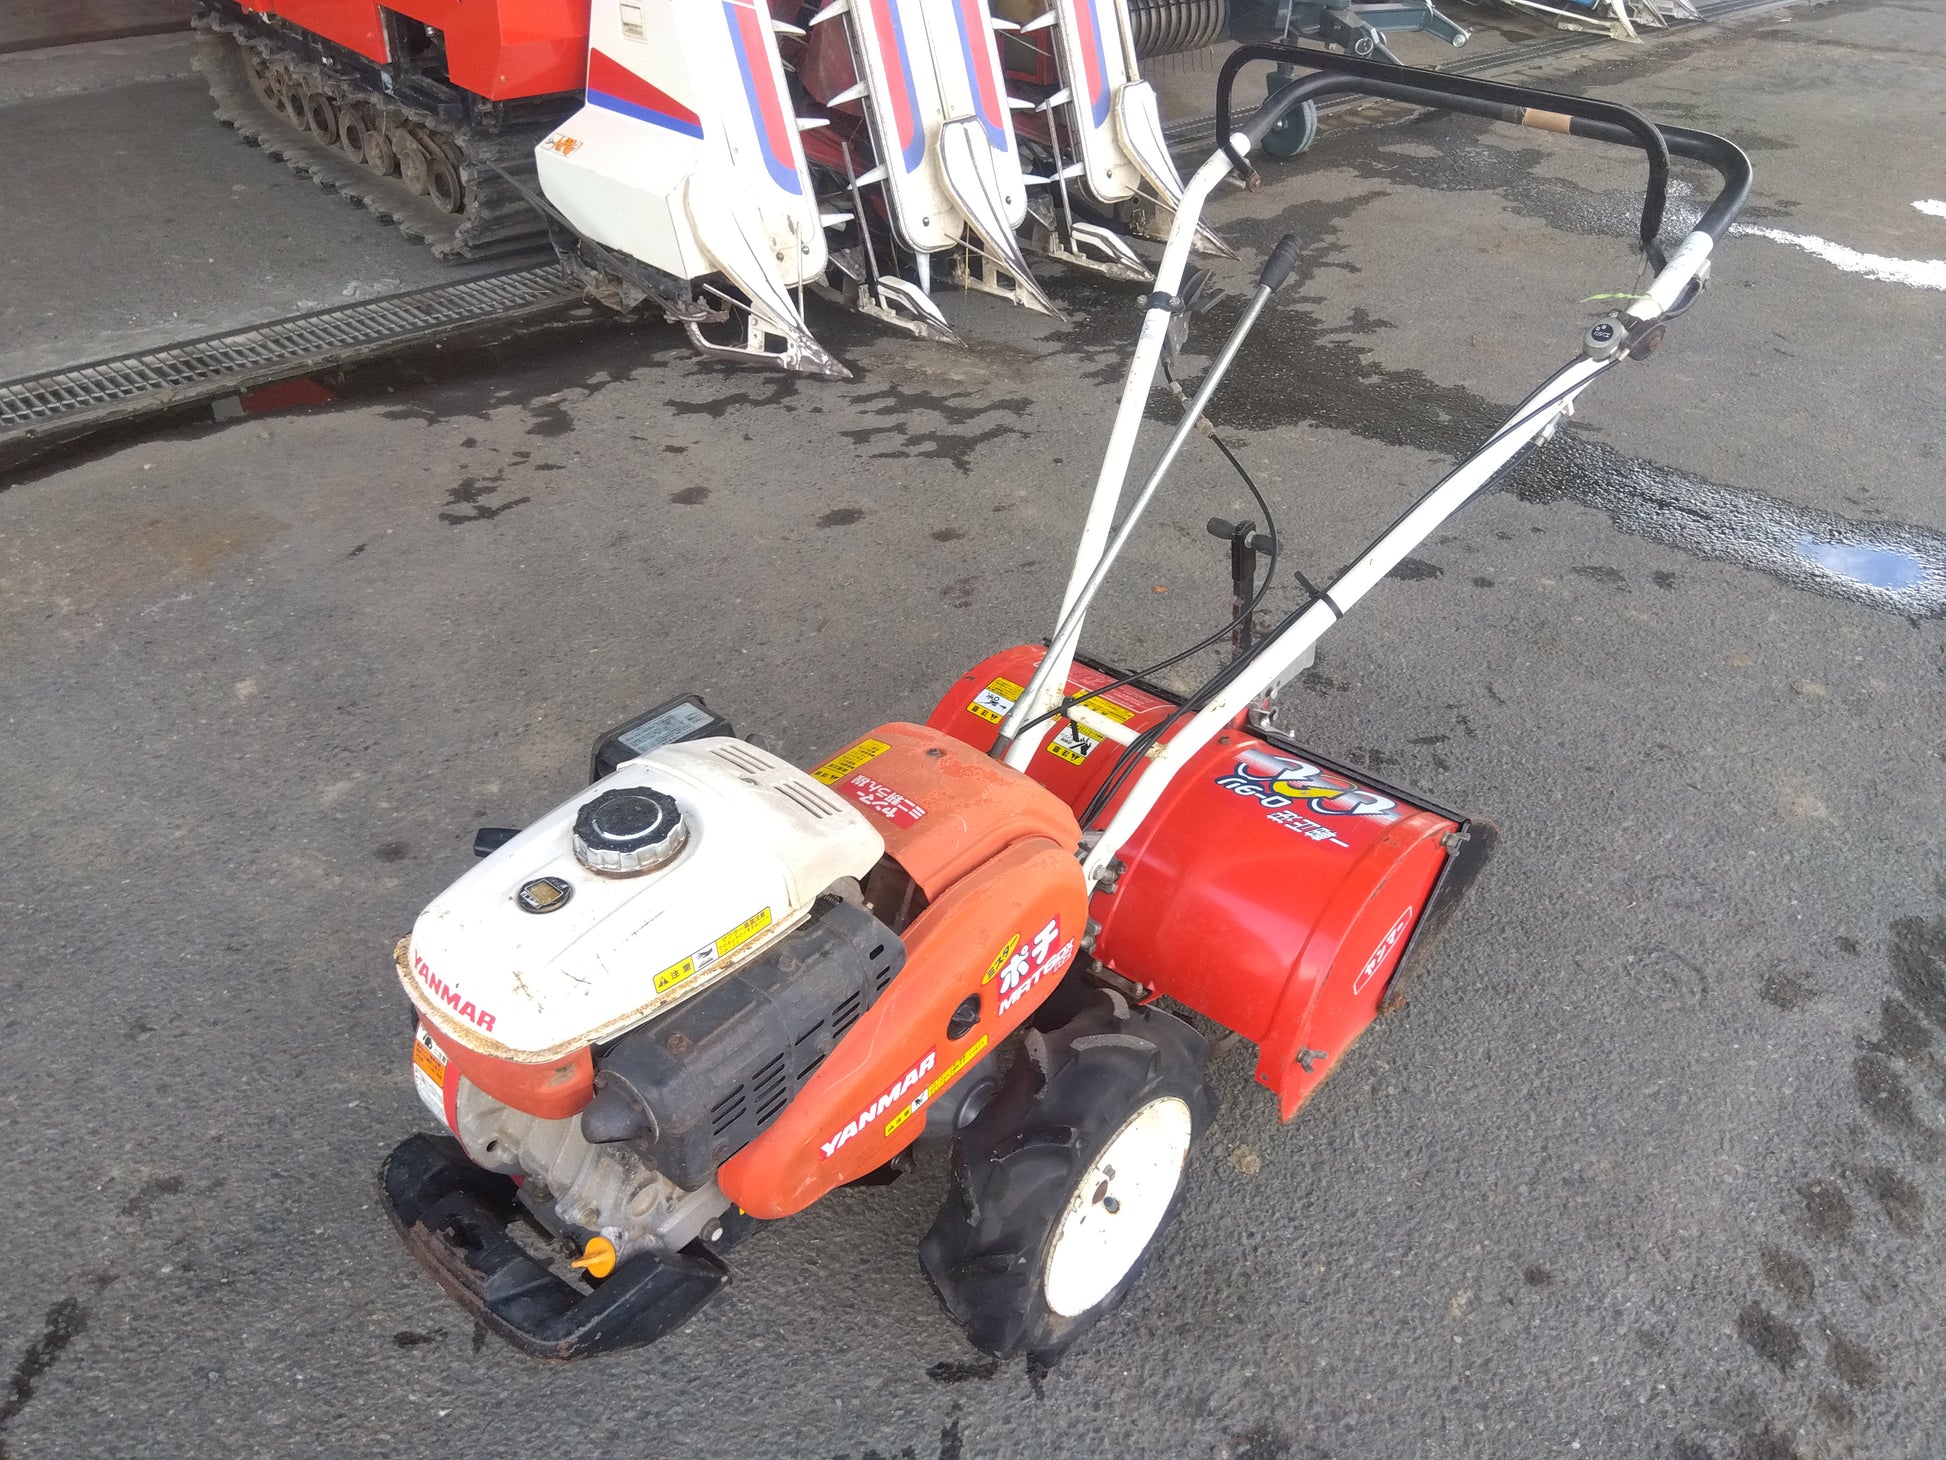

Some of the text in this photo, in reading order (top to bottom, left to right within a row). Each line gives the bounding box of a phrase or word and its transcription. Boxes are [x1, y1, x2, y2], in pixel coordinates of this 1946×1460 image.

[851, 774, 926, 820] ミニ耕うん機
[856, 790, 898, 818] ヤンマー
[670, 962, 692, 980] 注意
[986, 936, 1018, 979] ミスター
[1000, 918, 1059, 994] ポチ
[1364, 922, 1404, 976] ヤンマー
[414, 948, 497, 1033] YANMAR
[820, 1051, 937, 1158] YANMAR
